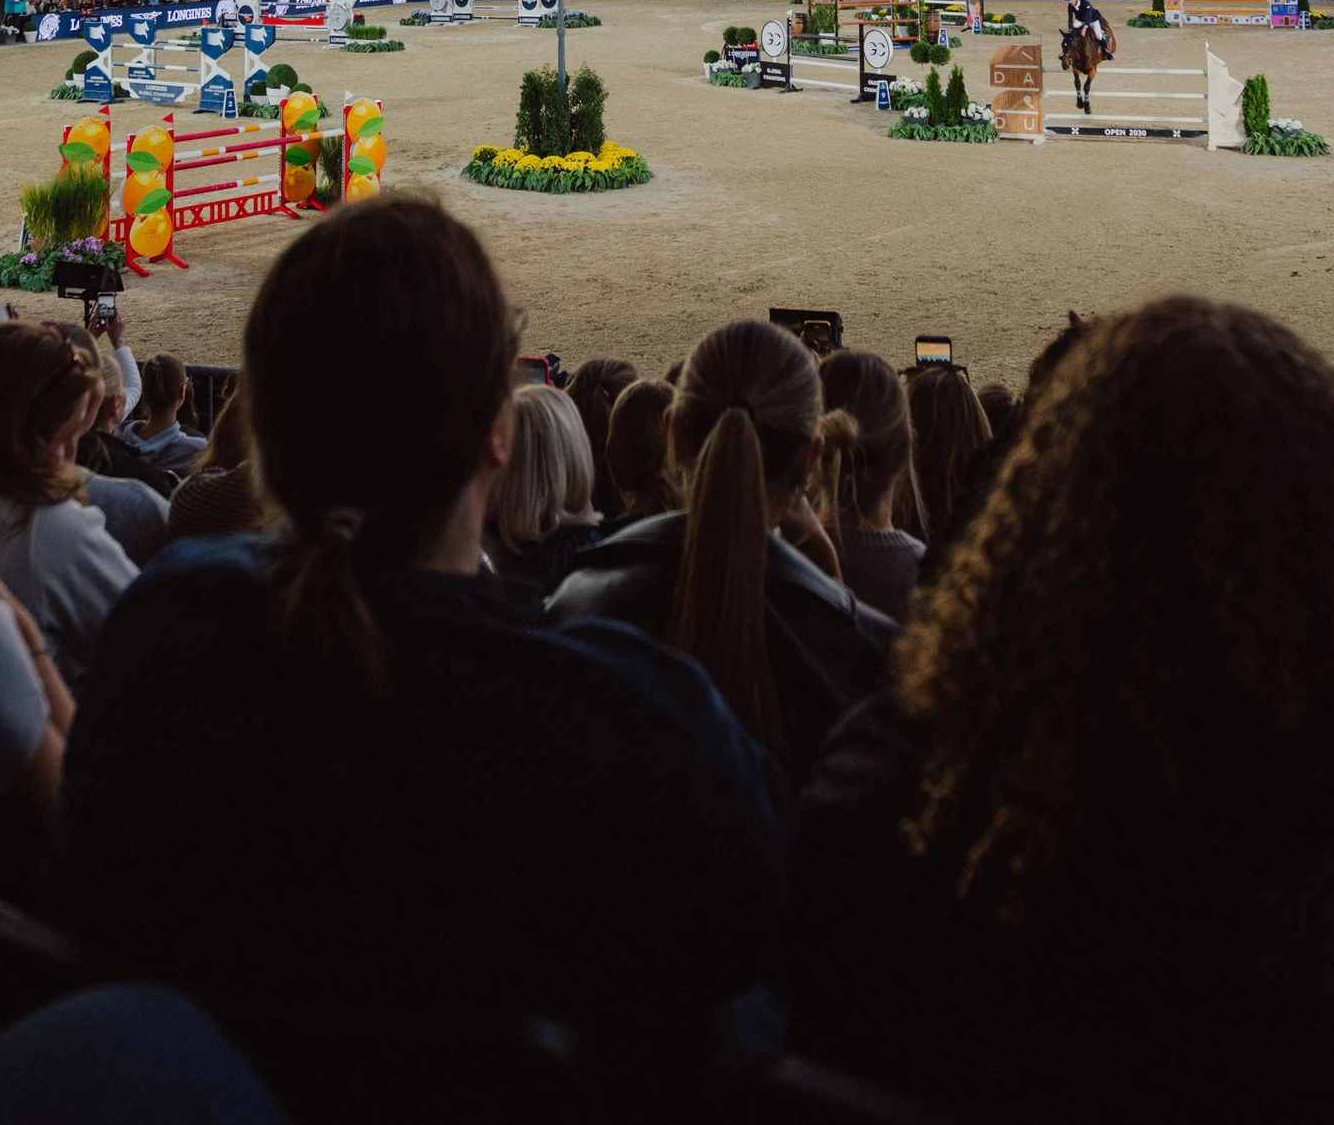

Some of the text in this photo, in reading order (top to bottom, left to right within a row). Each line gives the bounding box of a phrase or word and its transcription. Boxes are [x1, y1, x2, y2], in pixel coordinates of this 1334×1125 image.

[167, 7, 212, 23] LONGINES
[1104, 128, 1147, 137] OPEN 2030
